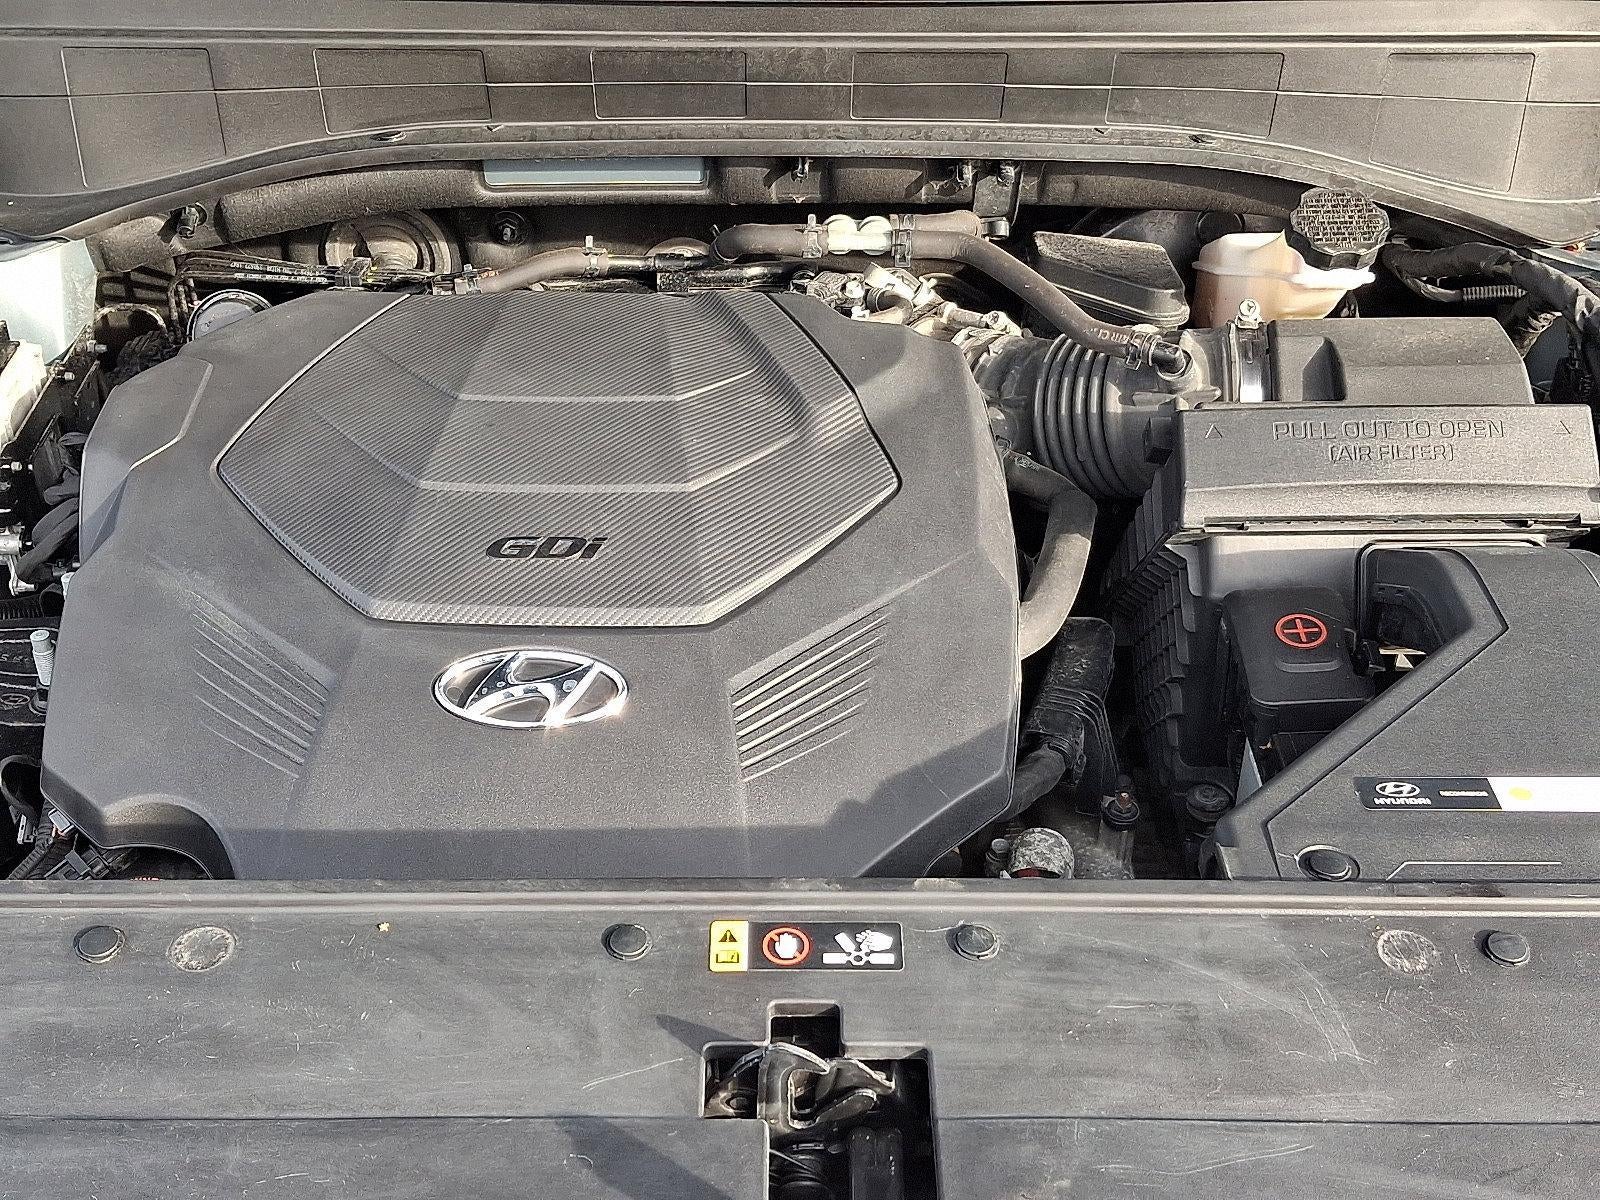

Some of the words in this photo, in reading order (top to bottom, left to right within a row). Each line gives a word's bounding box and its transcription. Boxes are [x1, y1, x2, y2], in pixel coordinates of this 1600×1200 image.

[1272, 421, 1337, 441] PULL
[1342, 419, 1393, 439] OUT
[1398, 418, 1433, 439] TO
[1439, 419, 1505, 439] OPEN
